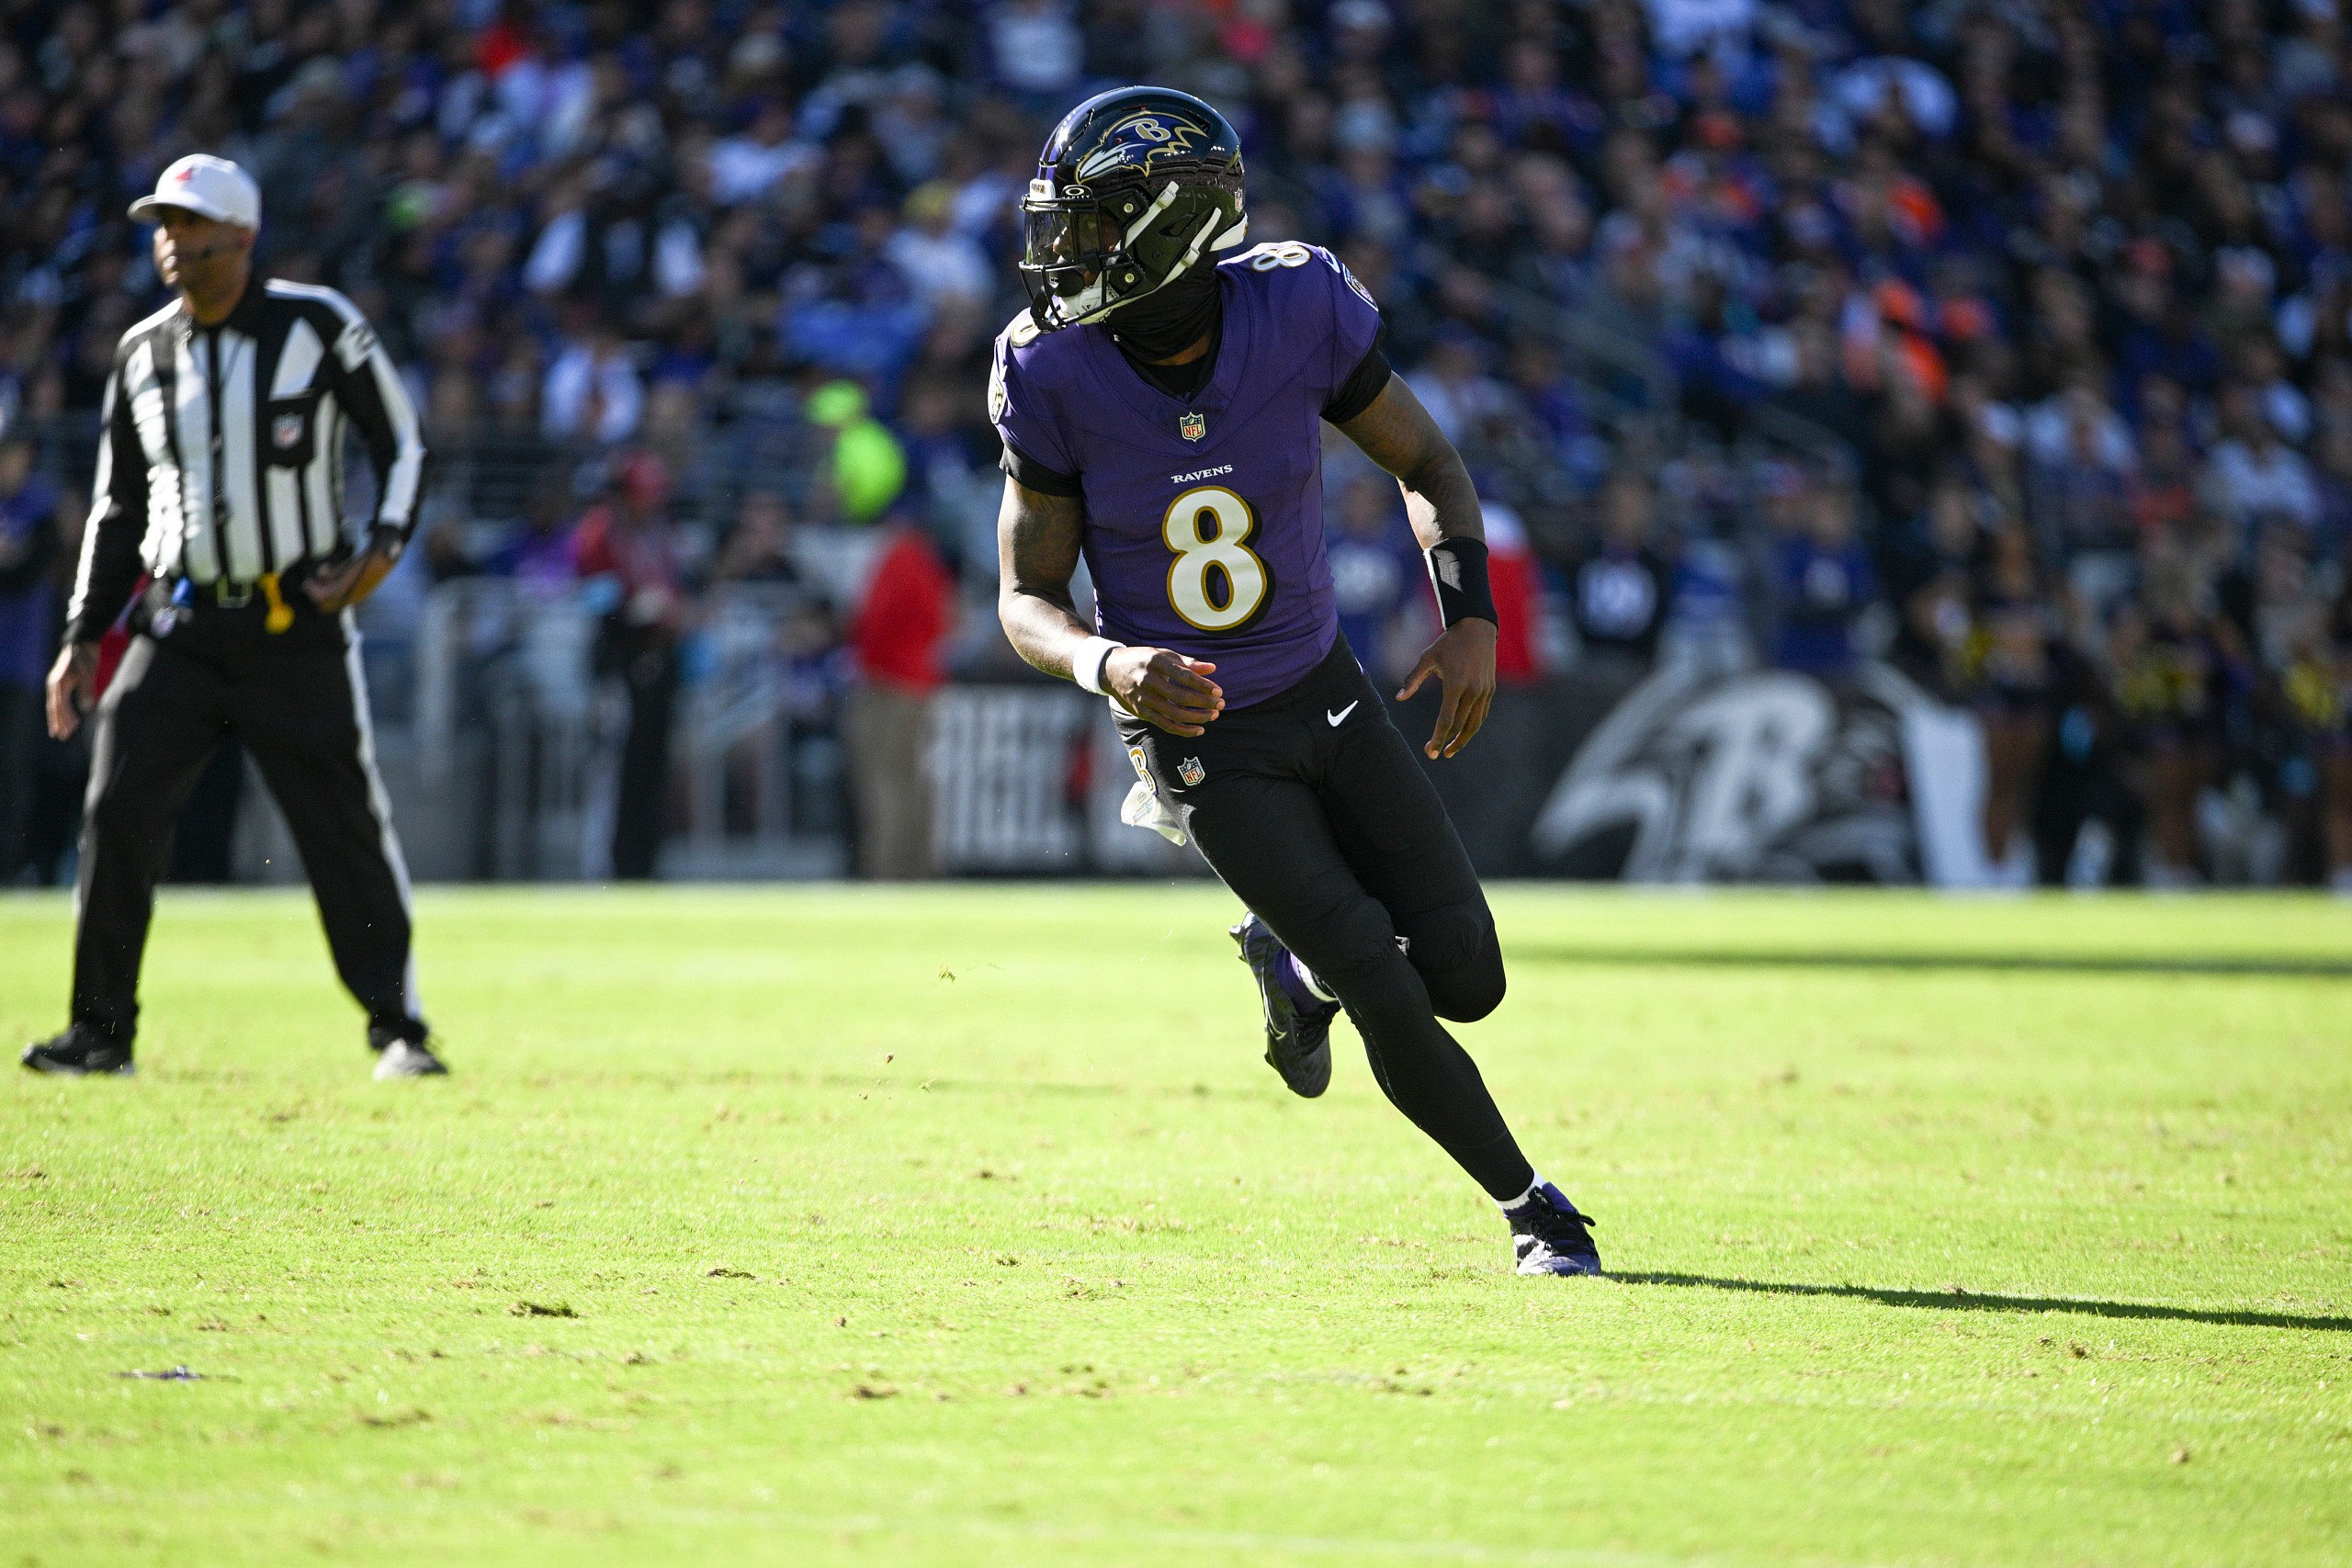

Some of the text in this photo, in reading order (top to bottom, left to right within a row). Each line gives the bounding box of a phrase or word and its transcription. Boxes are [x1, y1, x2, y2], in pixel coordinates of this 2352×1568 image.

[1250, 244, 1312, 273] 8
[1184, 424, 1203, 437] NFL
[1170, 464, 1233, 484] RAVENS
[1161, 485, 1270, 632] 8
[1184, 768, 1203, 783] NFL
